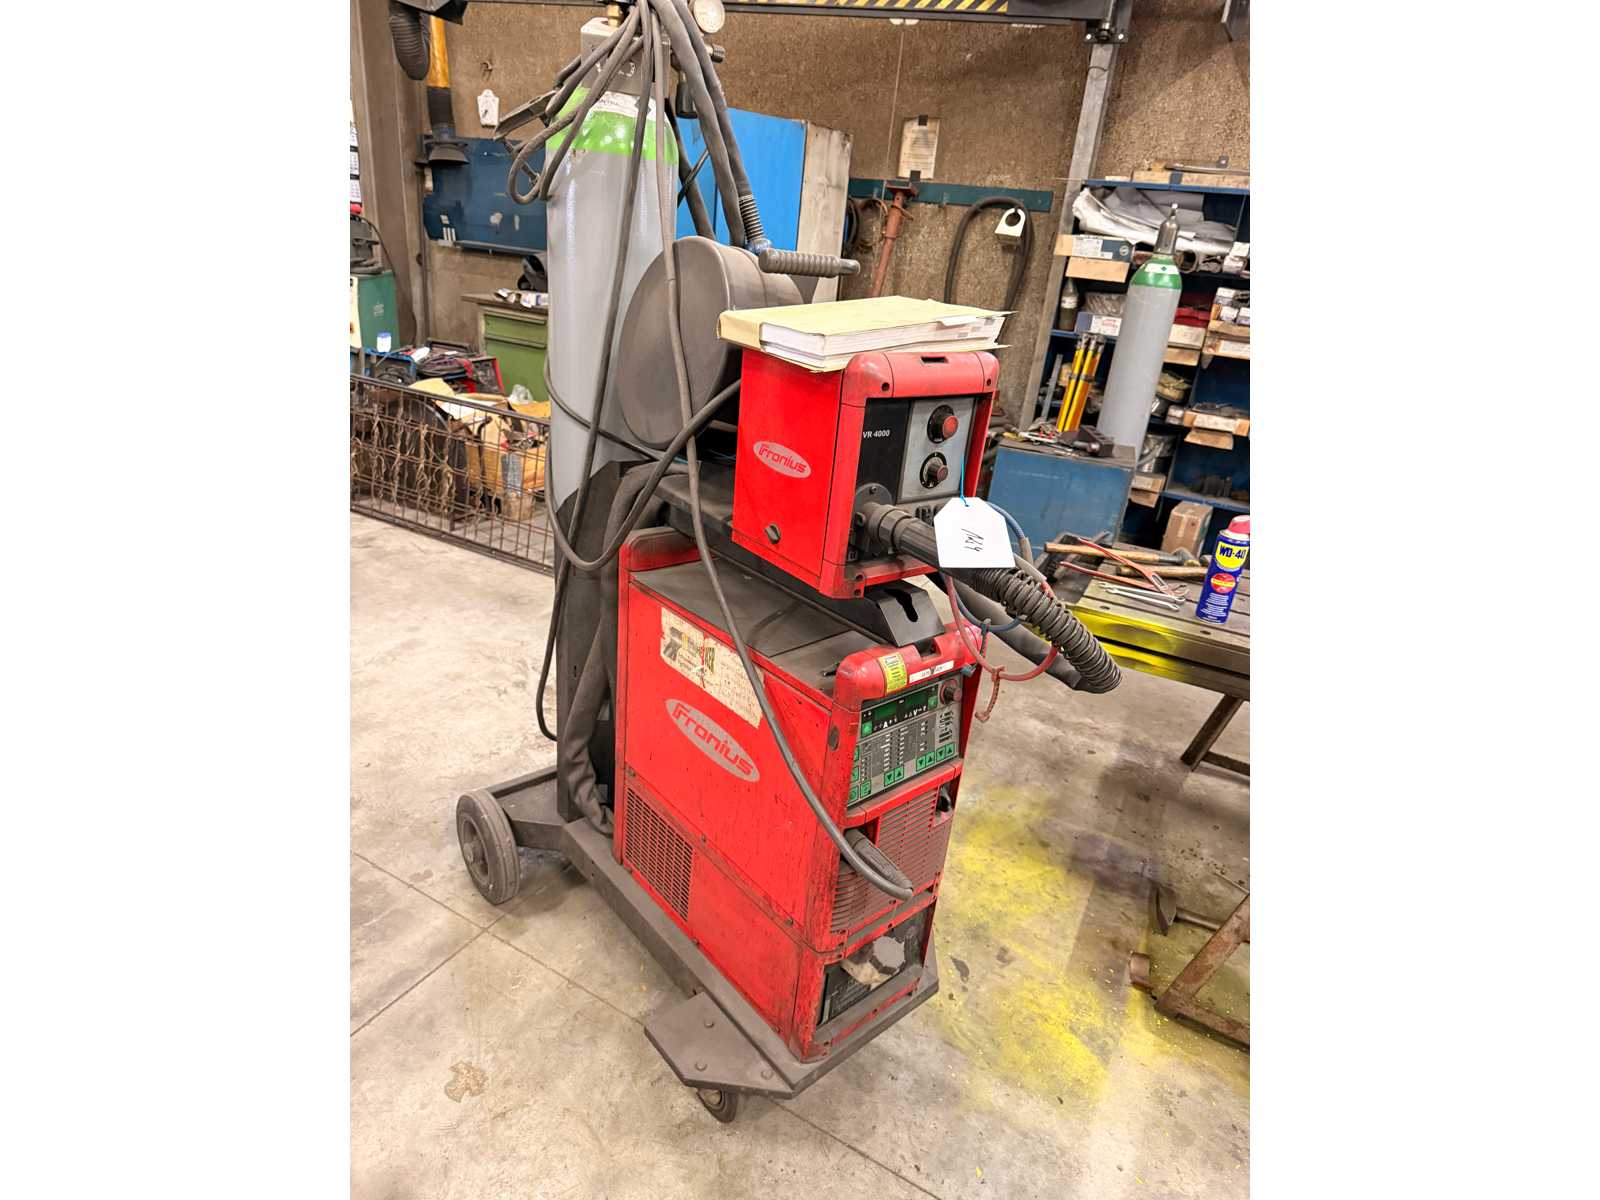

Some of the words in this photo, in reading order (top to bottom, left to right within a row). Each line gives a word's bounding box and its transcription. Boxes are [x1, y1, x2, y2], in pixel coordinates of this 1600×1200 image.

[873, 429, 890, 438] 4000
[758, 444, 806, 473] Fronius
[1219, 544, 1247, 560] WD-40
[672, 702, 754, 776] Fronius
